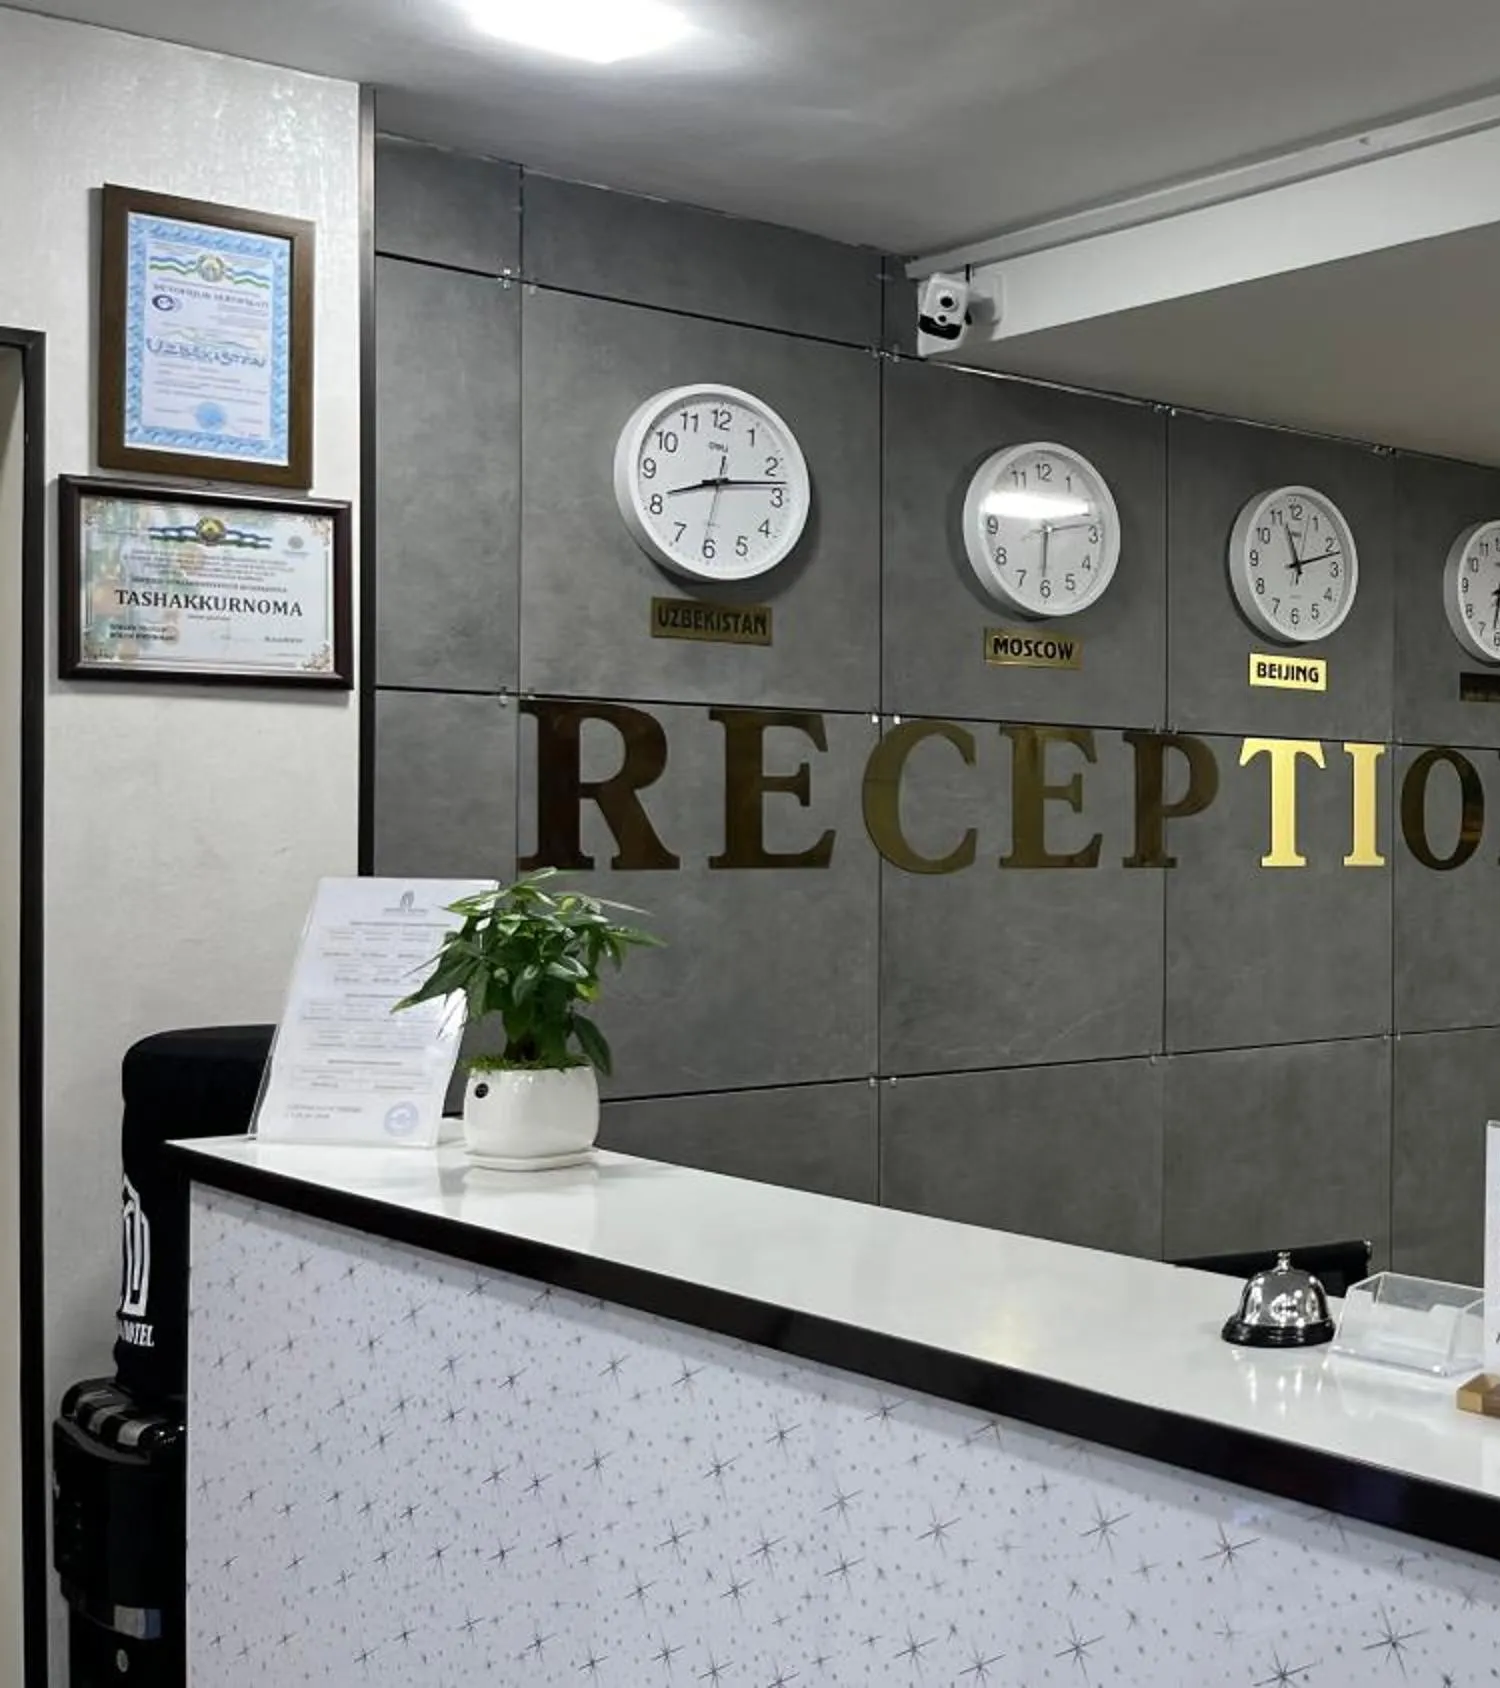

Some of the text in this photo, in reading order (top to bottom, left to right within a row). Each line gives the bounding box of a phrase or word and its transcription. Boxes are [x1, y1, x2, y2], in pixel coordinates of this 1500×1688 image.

[681, 412, 699, 432] 11
[711, 409, 732, 430] 12
[656, 431, 679, 453] 10
[747, 428, 756, 447] 1
[642, 458, 656, 479] 9
[765, 456, 779, 476] 2
[1035, 464, 1052, 482] 12
[1012, 470, 1027, 489] 11
[1066, 476, 1072, 493] 1
[649, 494, 663, 515] 8
[770, 488, 783, 508] 3
[1270, 510, 1283, 525] 11
[1288, 504, 1303, 520] 12
[674, 522, 687, 542] 7
[758, 519, 770, 538] 4
[986, 515, 998, 535] 9
[1312, 516, 1319, 531] 1
[1088, 525, 1099, 544] 3
[1256, 527, 1271, 544] 10
[702, 539, 715, 558] 6
[735, 536, 749, 556] 5
[1325, 538, 1334, 552] 2
[995, 547, 1007, 565] 8
[1082, 554, 1091, 570] 4
[1249, 550, 1259, 566] 9
[1016, 569, 1027, 588] 7
[1330, 562, 1339, 578] 3
[1040, 580, 1051, 597] 6
[1065, 574, 1076, 591] 5
[1255, 578, 1265, 594] 8
[115, 589, 303, 616] TASHAKKURNOMA
[1323, 587, 1332, 601] 4
[1272, 597, 1280, 613] 7
[1311, 603, 1320, 619] 5
[658, 607, 767, 636] UZBEKISTAN
[1291, 608, 1299, 624] 6
[993, 638, 1074, 660] MOSCOW
[1257, 662, 1319, 683] BEIJING
